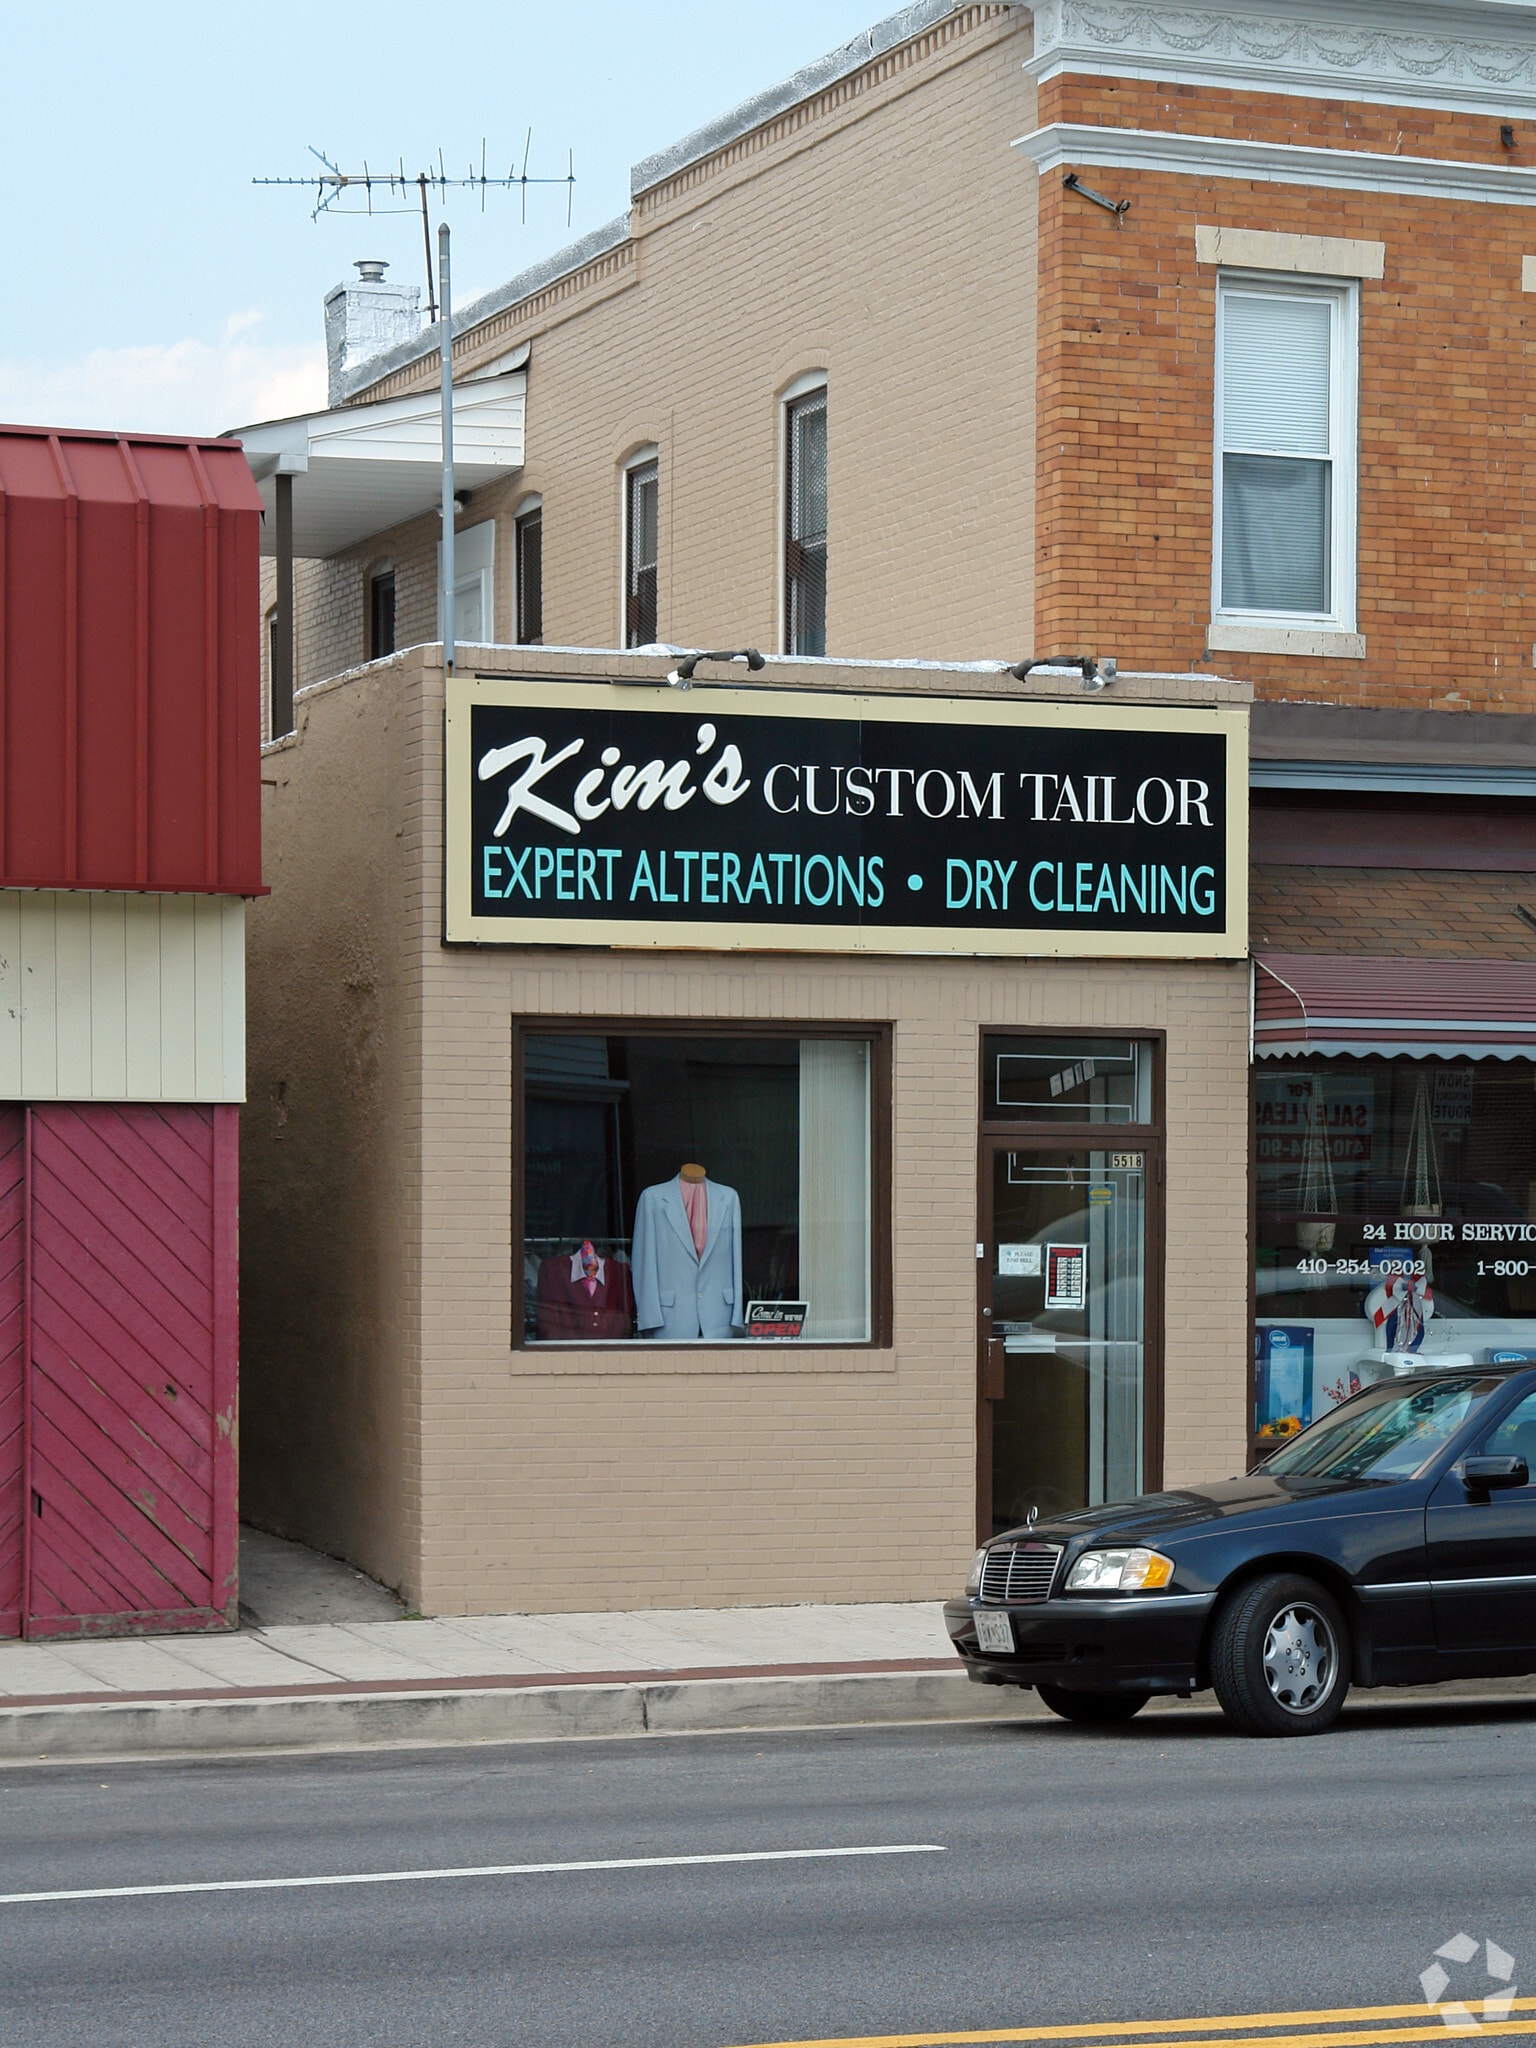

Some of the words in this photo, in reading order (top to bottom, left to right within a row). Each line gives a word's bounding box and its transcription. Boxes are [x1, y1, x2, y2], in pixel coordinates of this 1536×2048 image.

[478, 723, 750, 837] Kim's
[763, 764, 1005, 820] CUSTOM
[1019, 773, 1214, 827] TAILOR
[483, 846, 622, 900] EXPERT
[629, 850, 885, 907] ALTERATIONS
[946, 859, 1018, 910] DRY
[1029, 861, 1216, 915] CLEANING
[1114, 1155, 1142, 1168] 5518
[1363, 1224, 1386, 1240] 24
[1394, 1222, 1455, 1241] HOUR
[1462, 1223, 1536, 1241] SERVIC
[1296, 1258, 1426, 1275] 410-254-0202
[750, 1322, 801, 1336] OPEN
